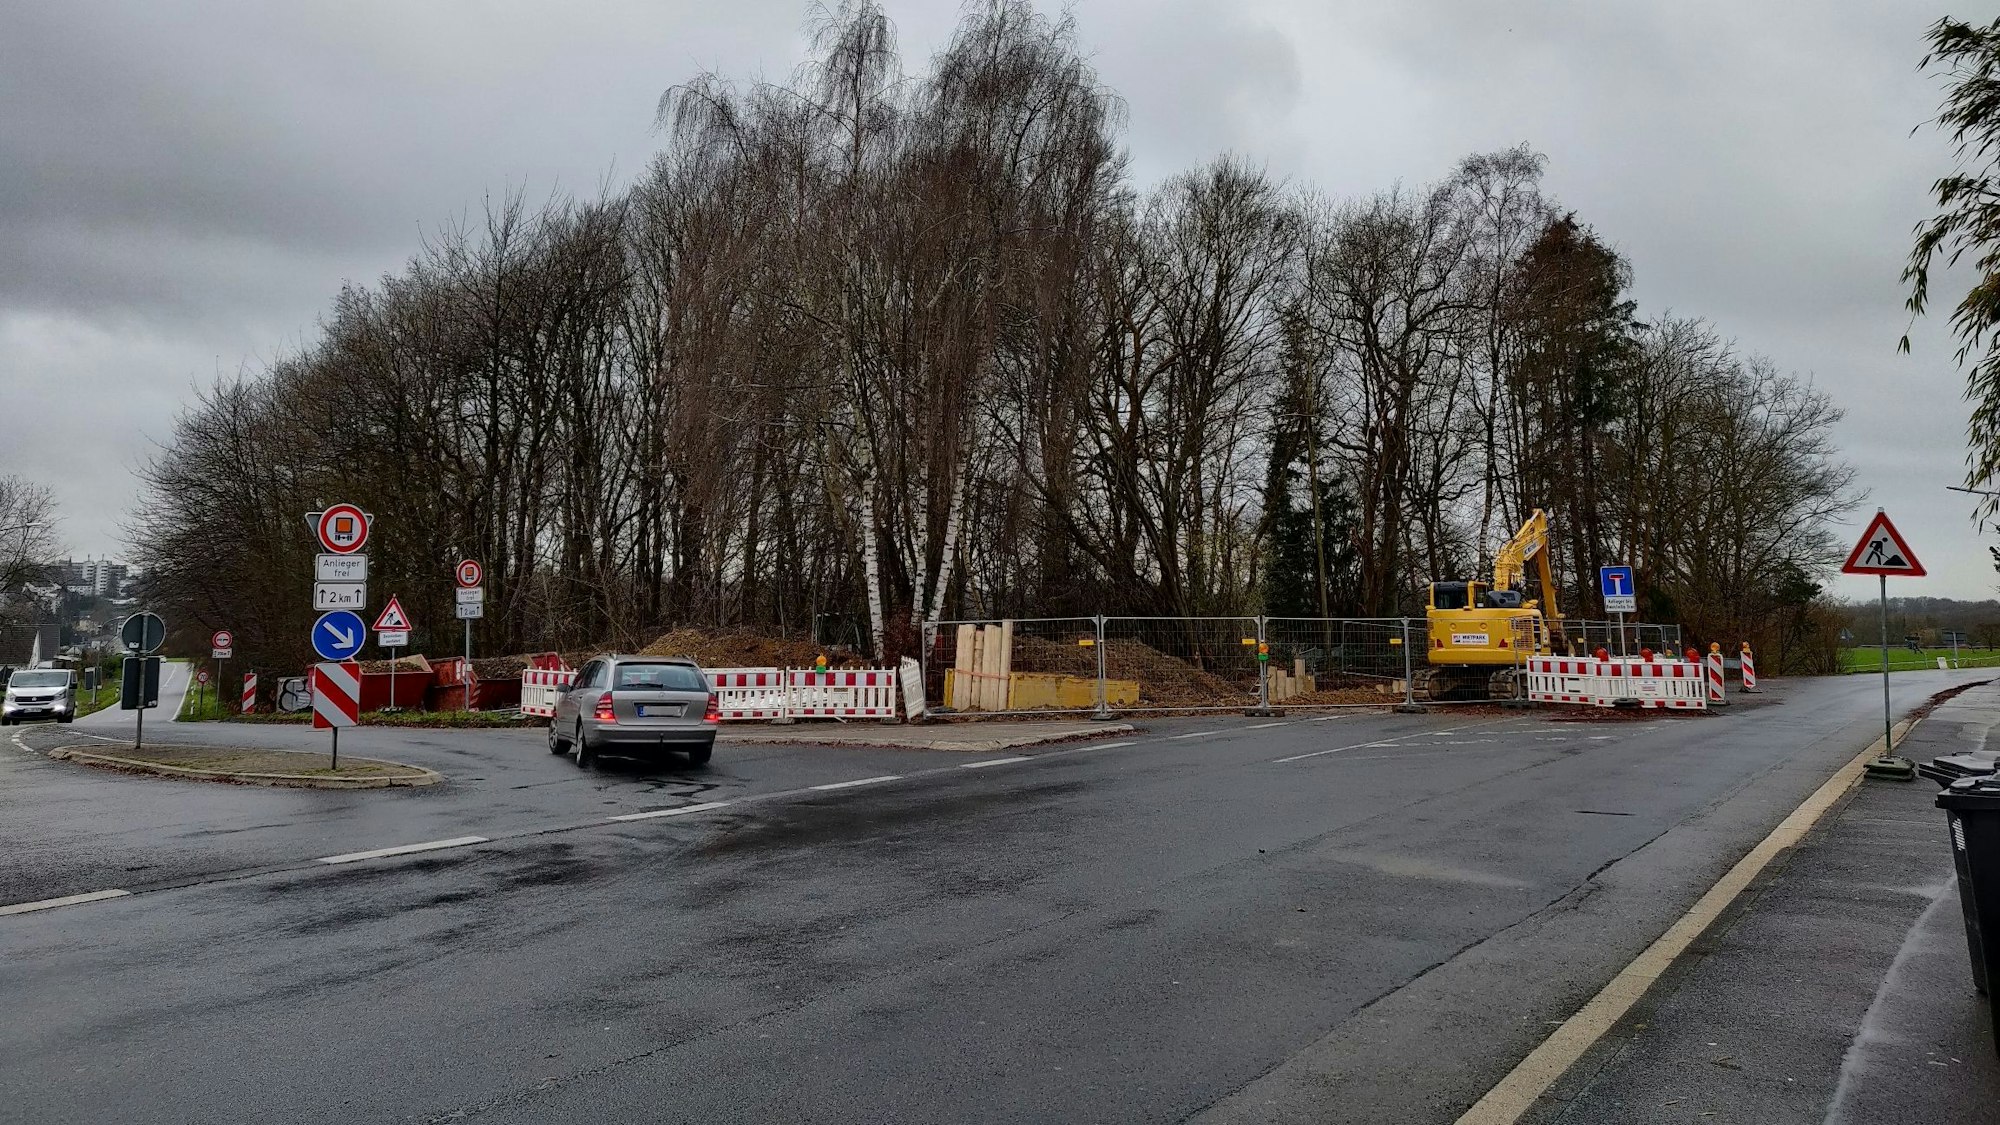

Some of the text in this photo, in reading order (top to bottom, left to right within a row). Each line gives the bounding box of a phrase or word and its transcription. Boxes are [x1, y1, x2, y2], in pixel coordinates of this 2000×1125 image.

[323, 559, 360, 569] Anlieger
[334, 569, 350, 577] frei
[329, 591, 352, 603] 2 km
